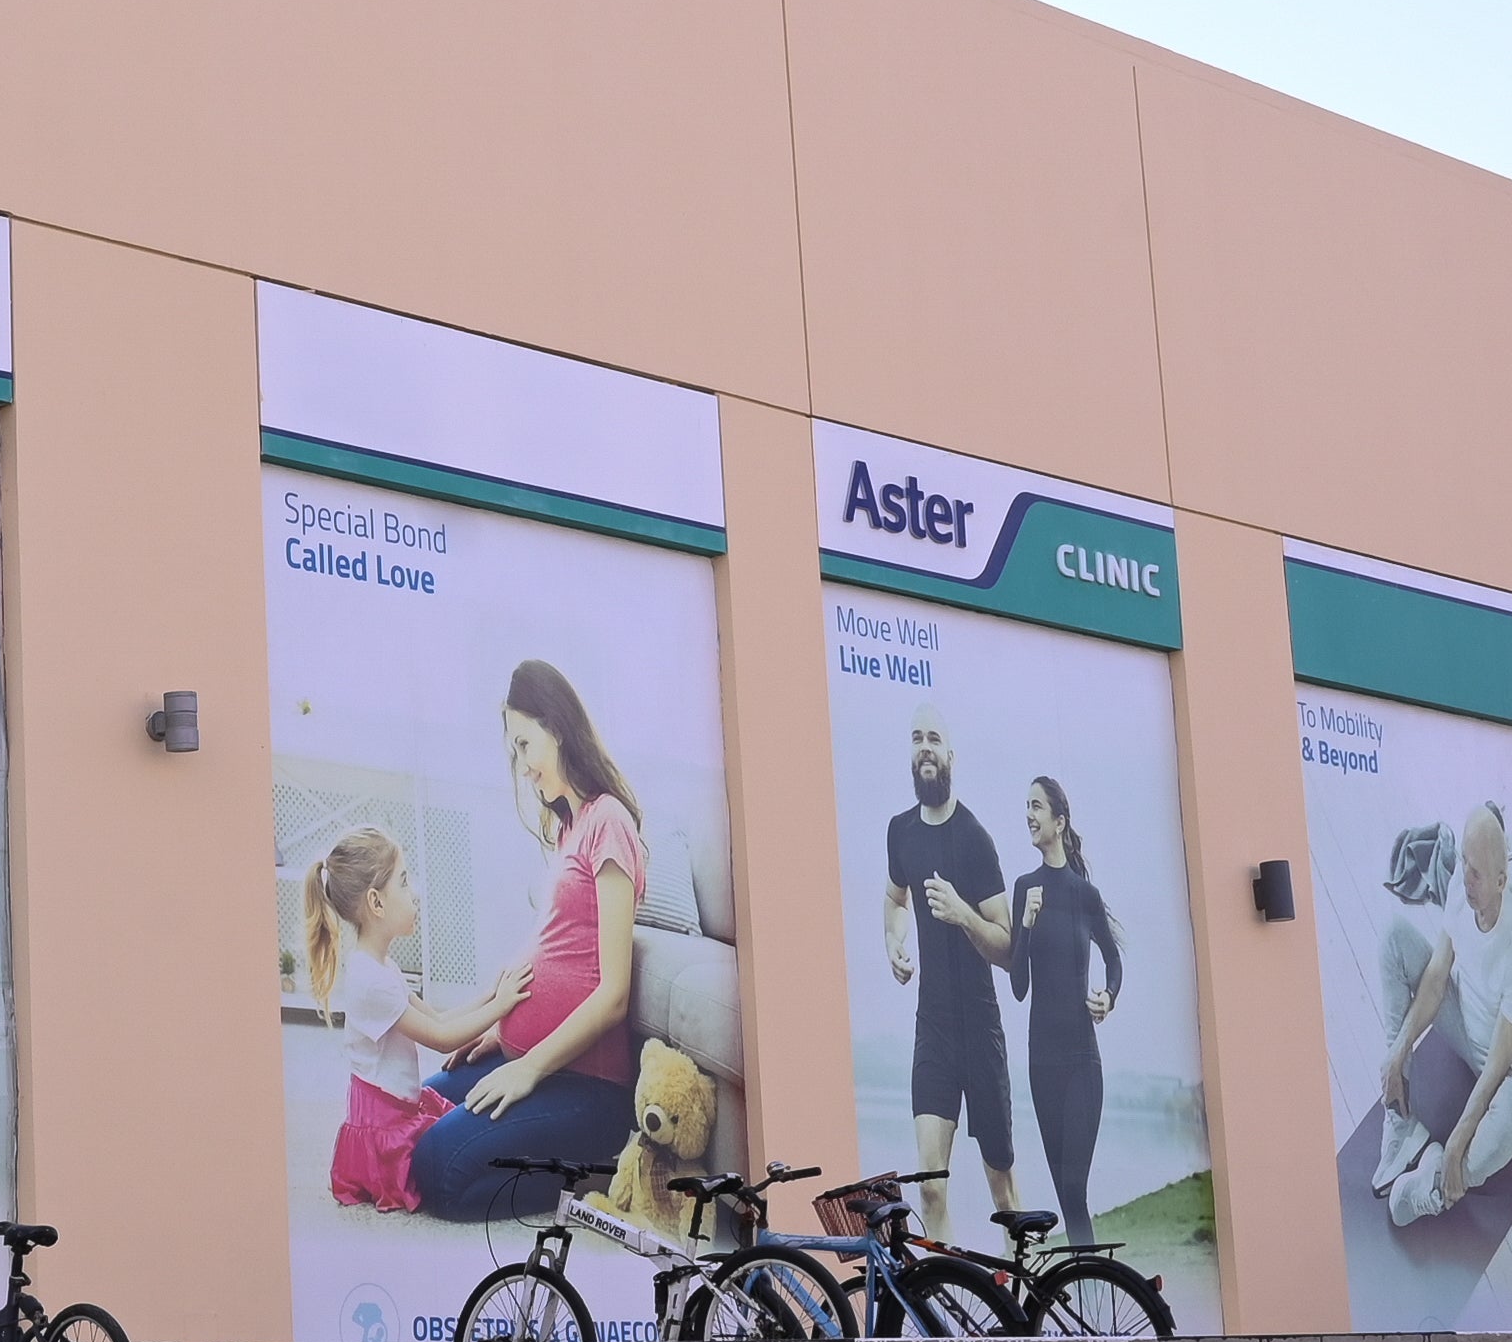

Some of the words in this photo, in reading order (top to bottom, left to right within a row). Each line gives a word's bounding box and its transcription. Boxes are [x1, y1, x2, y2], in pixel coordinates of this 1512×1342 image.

[284, 492, 375, 540] Special
[384, 513, 447, 554] Bond
[842, 460, 974, 548] Aster
[286, 537, 367, 581] Called
[376, 555, 435, 594] Love
[1056, 544, 1162, 597] CLINIC
[837, 605, 891, 641] Move
[896, 617, 939, 651] Well
[840, 645, 881, 677] Live
[885, 653, 931, 687] Well
[1297, 701, 1316, 728] To
[1320, 706, 1382, 748] Mobility
[1302, 736, 1315, 761] &
[1318, 740, 1379, 775] Beyond
[570, 1205, 595, 1225] LAND
[595, 1219, 627, 1241] ROVER
